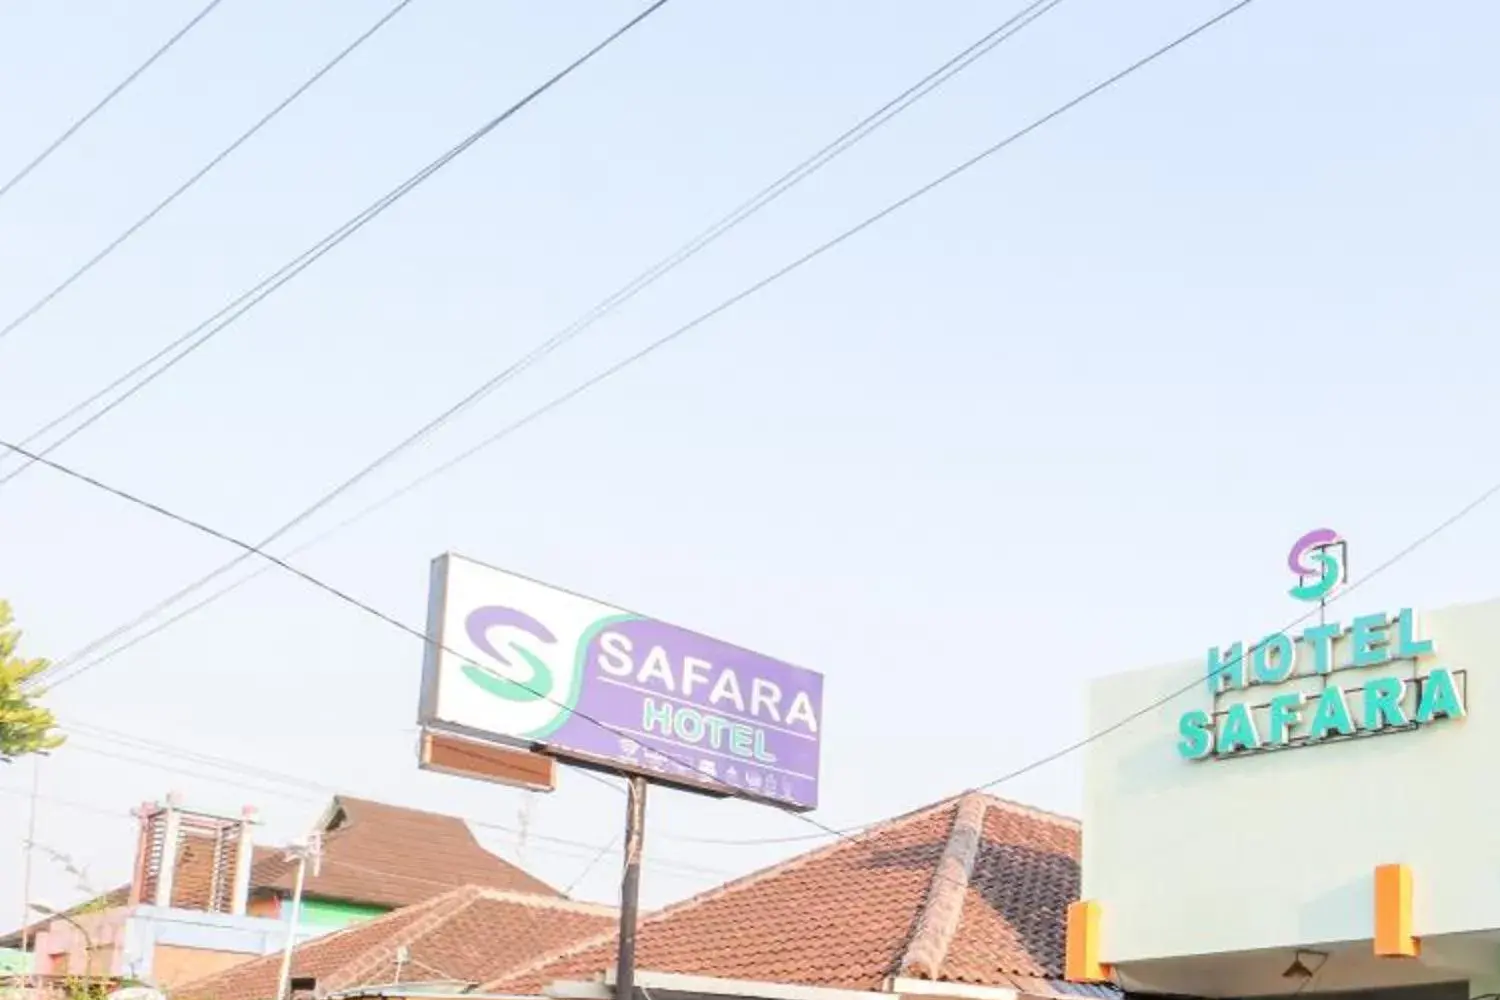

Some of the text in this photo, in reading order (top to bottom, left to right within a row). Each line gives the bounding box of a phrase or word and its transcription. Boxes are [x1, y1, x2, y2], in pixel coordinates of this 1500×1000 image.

[597, 631, 818, 732] SAFARA
[1206, 607, 1435, 693] HOTEL
[642, 697, 777, 763] HOTEL
[1177, 668, 1466, 761] SAFARA
